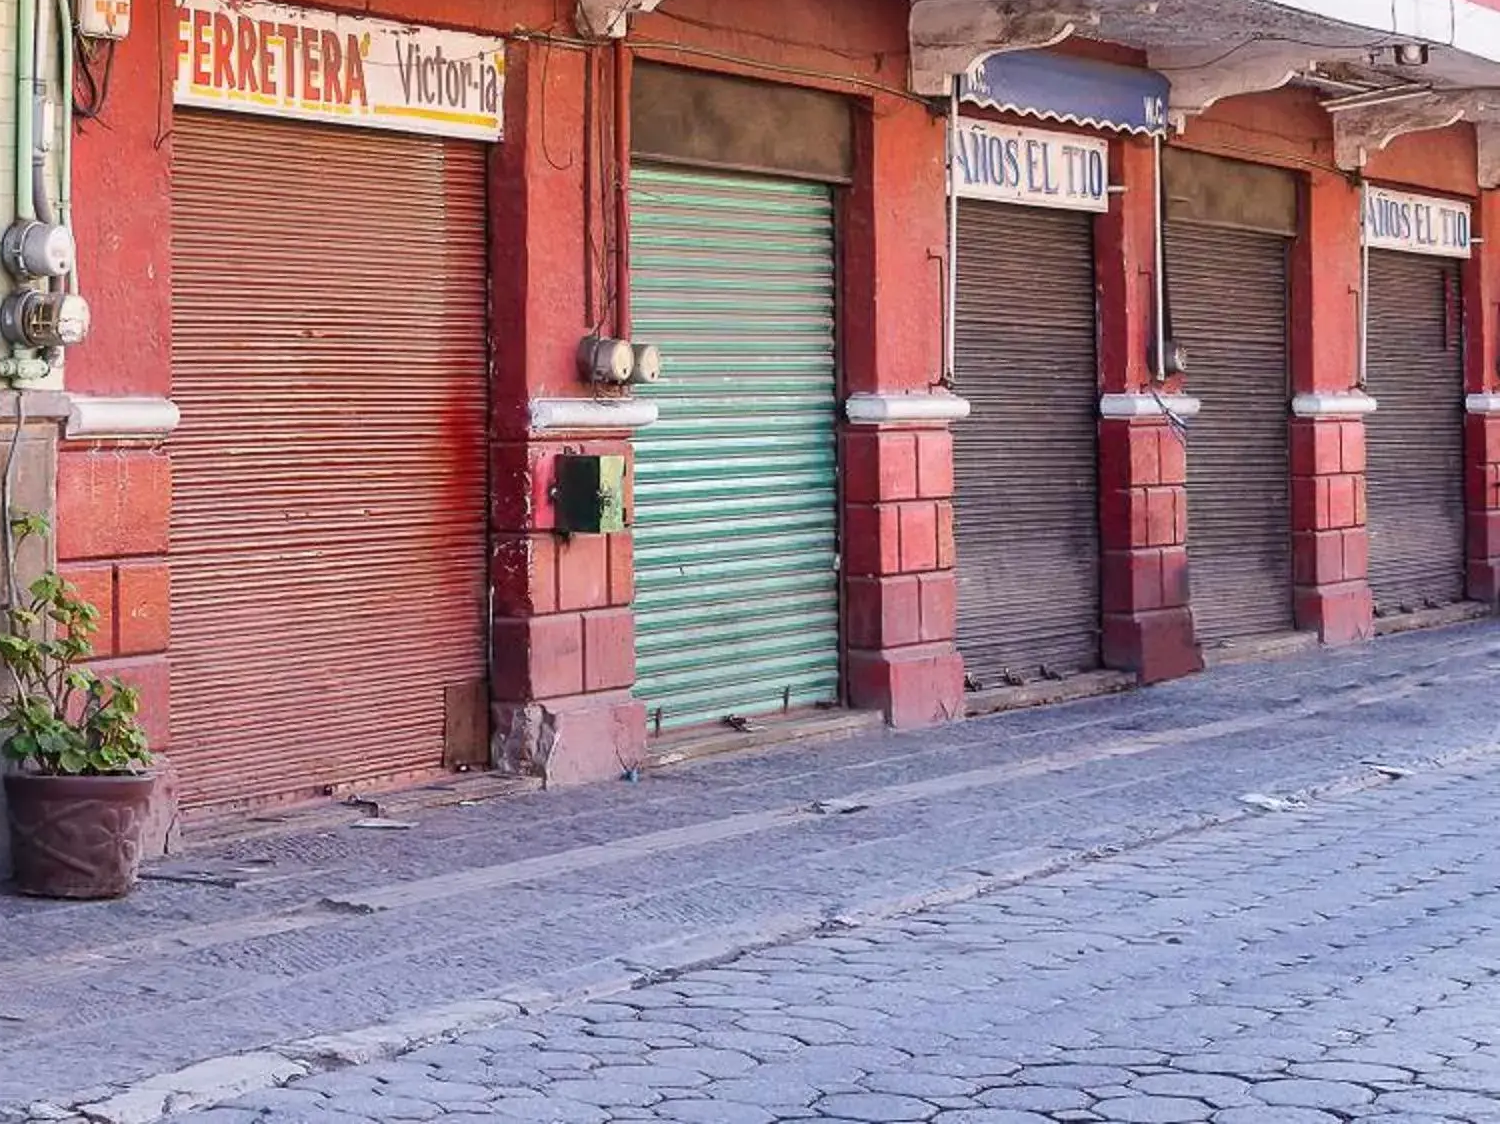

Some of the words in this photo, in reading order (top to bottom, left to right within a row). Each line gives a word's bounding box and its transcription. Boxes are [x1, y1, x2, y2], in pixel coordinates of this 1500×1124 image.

[1026, 139, 1060, 195] EL
[1062, 145, 1103, 201] TIO
[1414, 203, 1439, 245] EL
[1440, 207, 1468, 248] TIO
